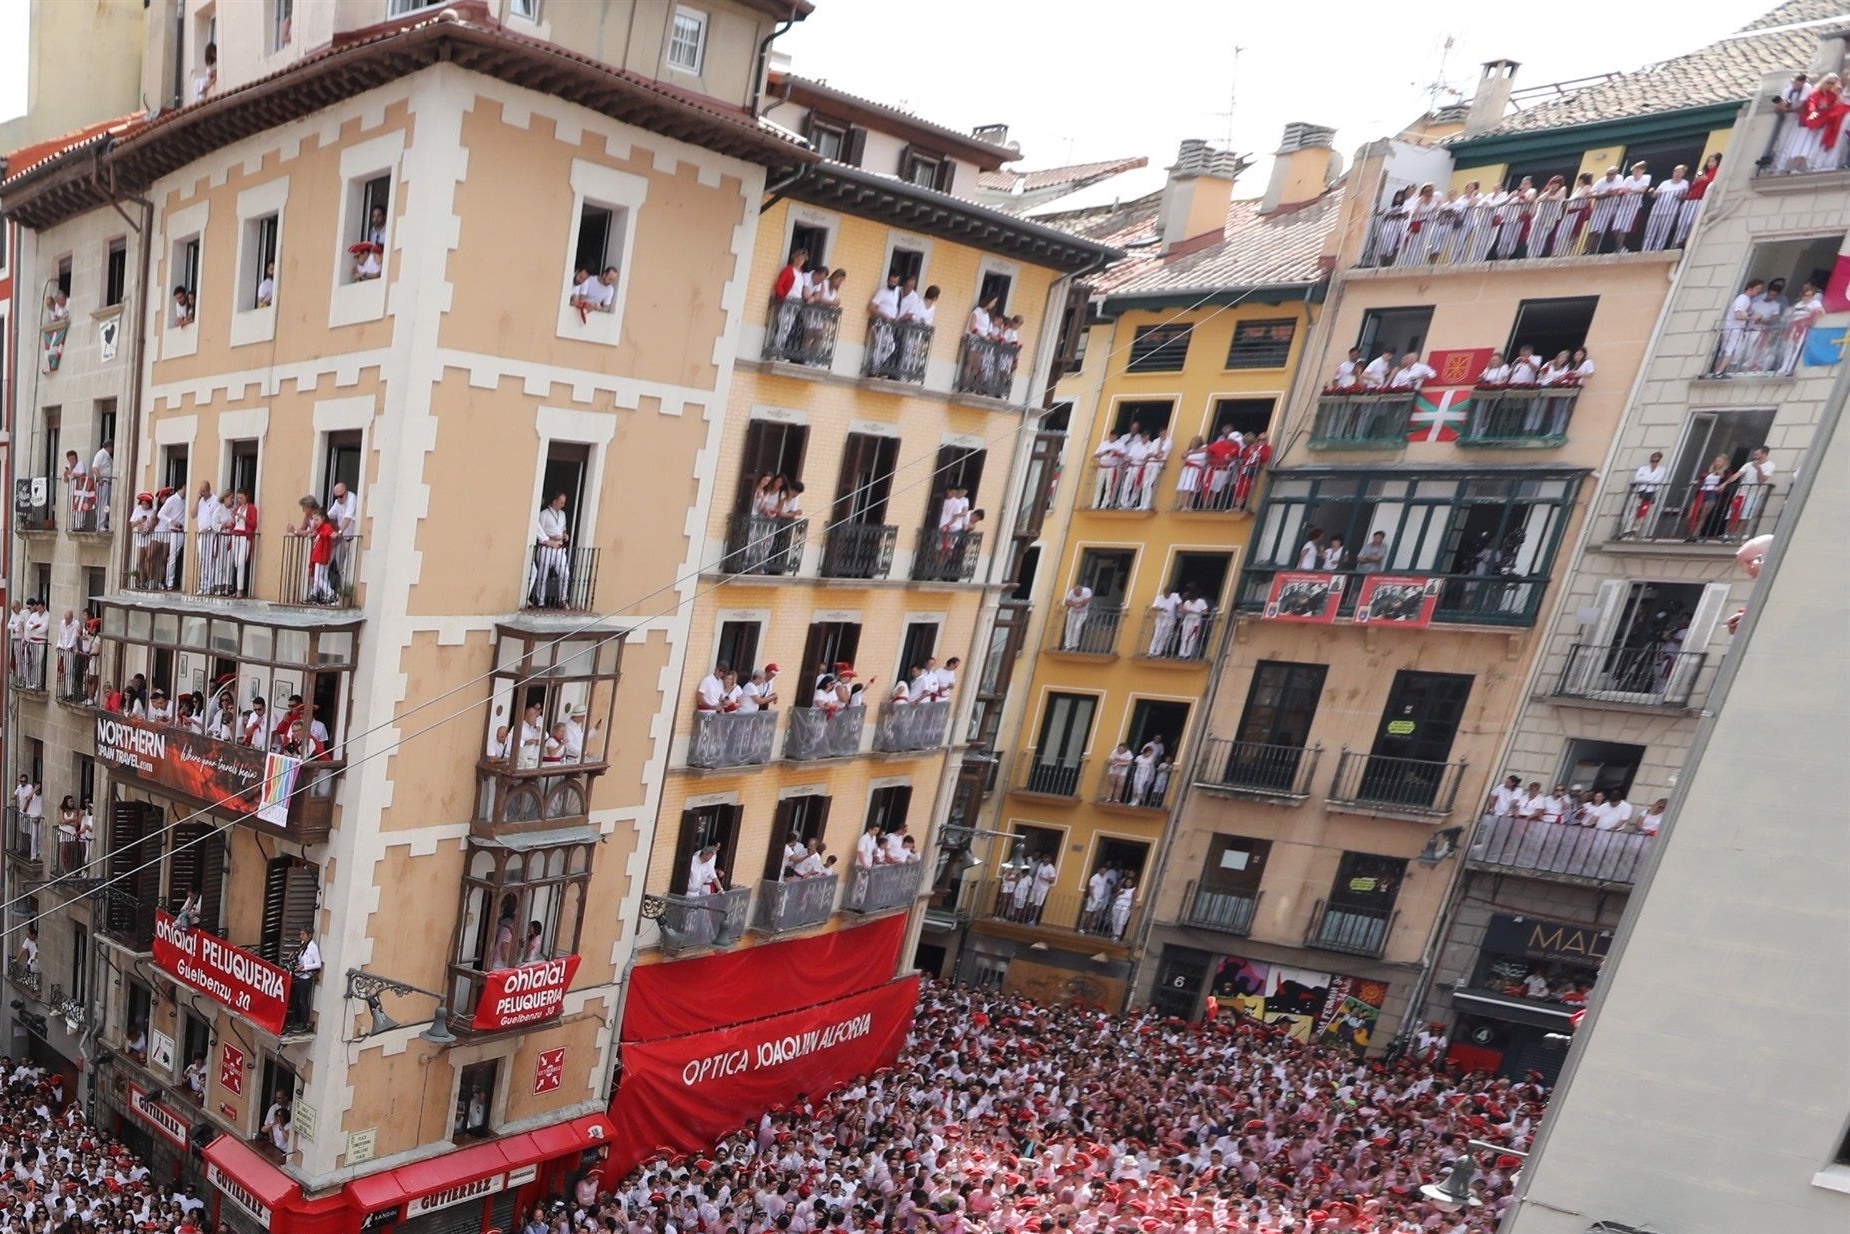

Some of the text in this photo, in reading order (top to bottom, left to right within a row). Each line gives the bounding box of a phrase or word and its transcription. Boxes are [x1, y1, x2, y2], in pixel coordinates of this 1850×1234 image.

[97, 717, 166, 760] NORTHERN
[97, 744, 115, 762] SPAIN
[177, 958, 251, 1011] Guelbenzu, 30
[203, 938, 285, 1003] PELUQUERIA
[1173, 976, 1186, 988] 6
[496, 988, 563, 1016] PELUQUERIA
[1476, 1029, 1489, 1042] 4
[682, 1049, 748, 1086] OPTICA
[754, 1028, 820, 1070] JOAQUIN
[139, 1096, 180, 1137] GUTIERREZ
[216, 1169, 264, 1219] GUTIERREZ
[420, 1177, 492, 1210] GUTIERREZ
